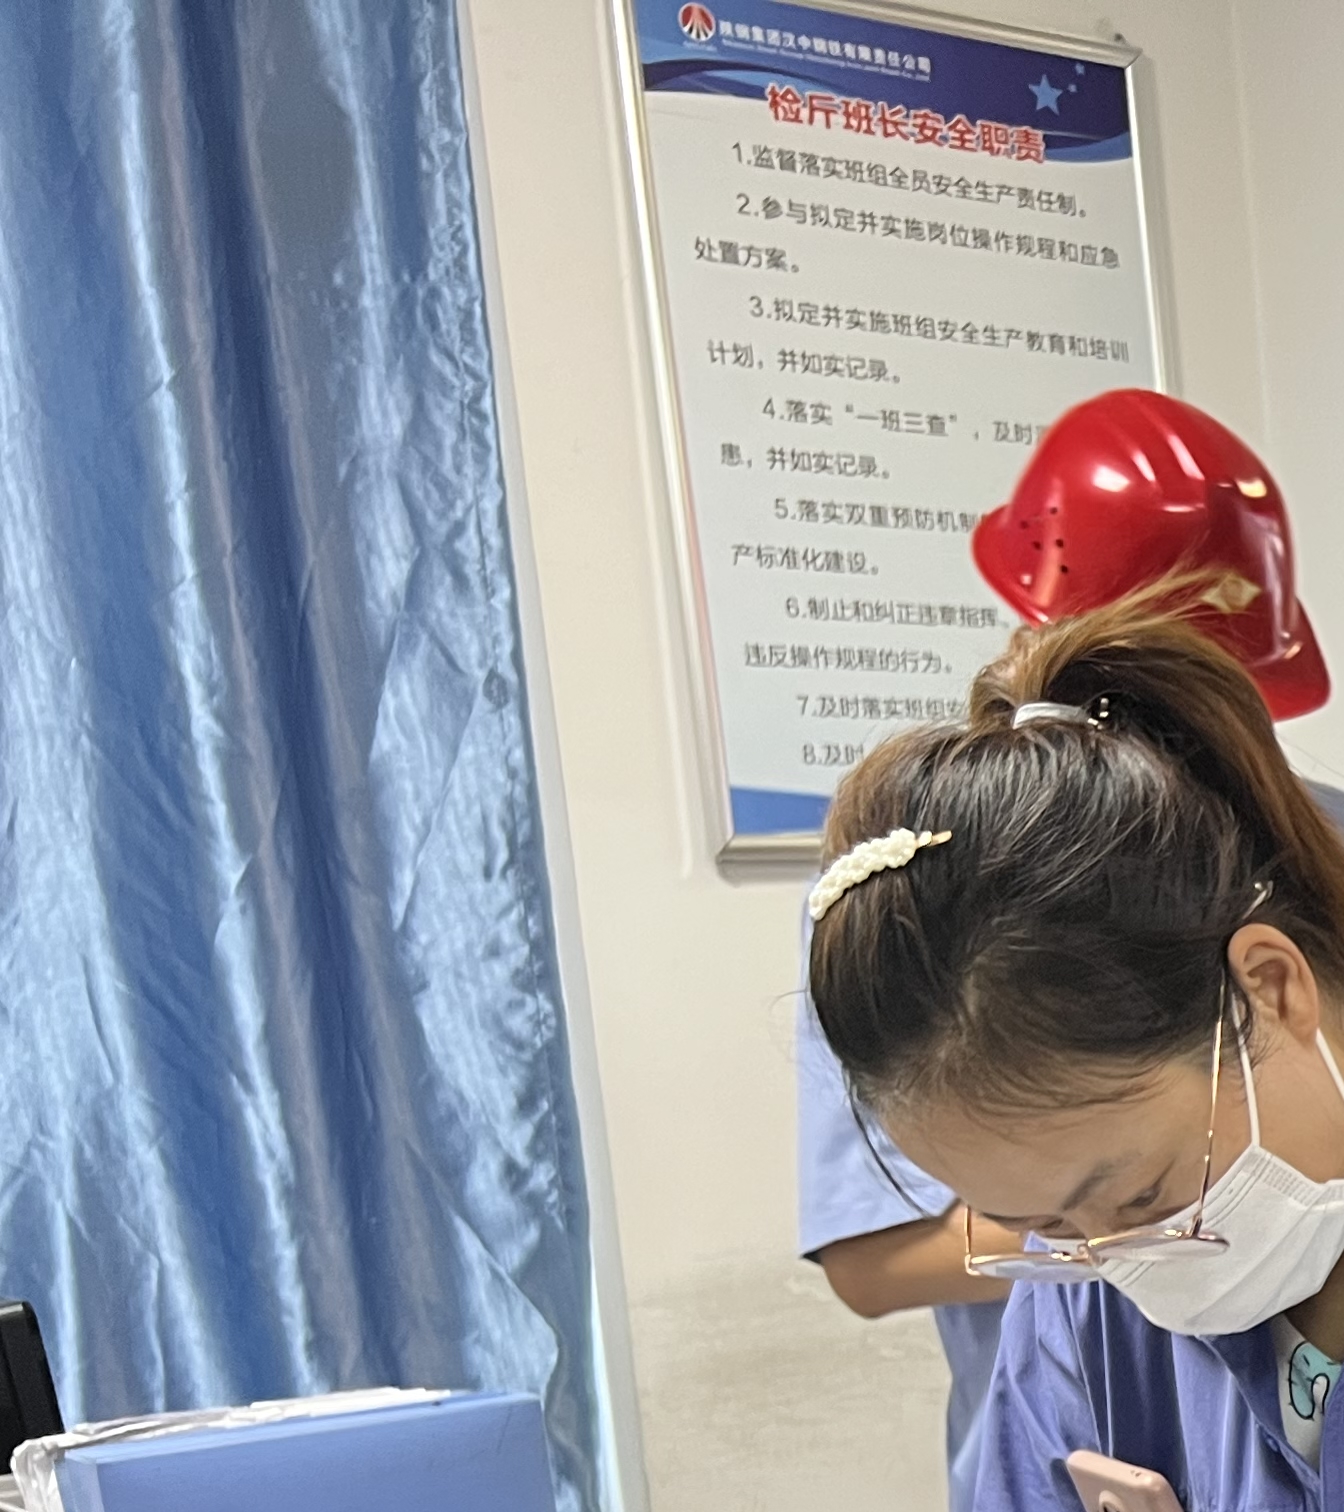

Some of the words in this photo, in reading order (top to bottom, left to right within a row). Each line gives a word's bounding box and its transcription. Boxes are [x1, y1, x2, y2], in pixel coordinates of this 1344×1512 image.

[767, 83, 1046, 163] 检斤班长安全职责
[732, 142, 1087, 217] 1.监督落实班组全员安全生产责任制。
[694, 236, 800, 273] 处置方案。
[736, 193, 1120, 269] 2.参与拟定并实施岗位操作规程和应急
[749, 294, 1130, 364] 3.拟定并实施班组安全生产教育和培训
[706, 339, 902, 384] 计划，并如实记录。
[762, 397, 1048, 446] 4.落实“一班三查”，及时
[731, 543, 880, 576] 产标准化建设。
[744, 642, 953, 674] 违反操作规程的行为。
